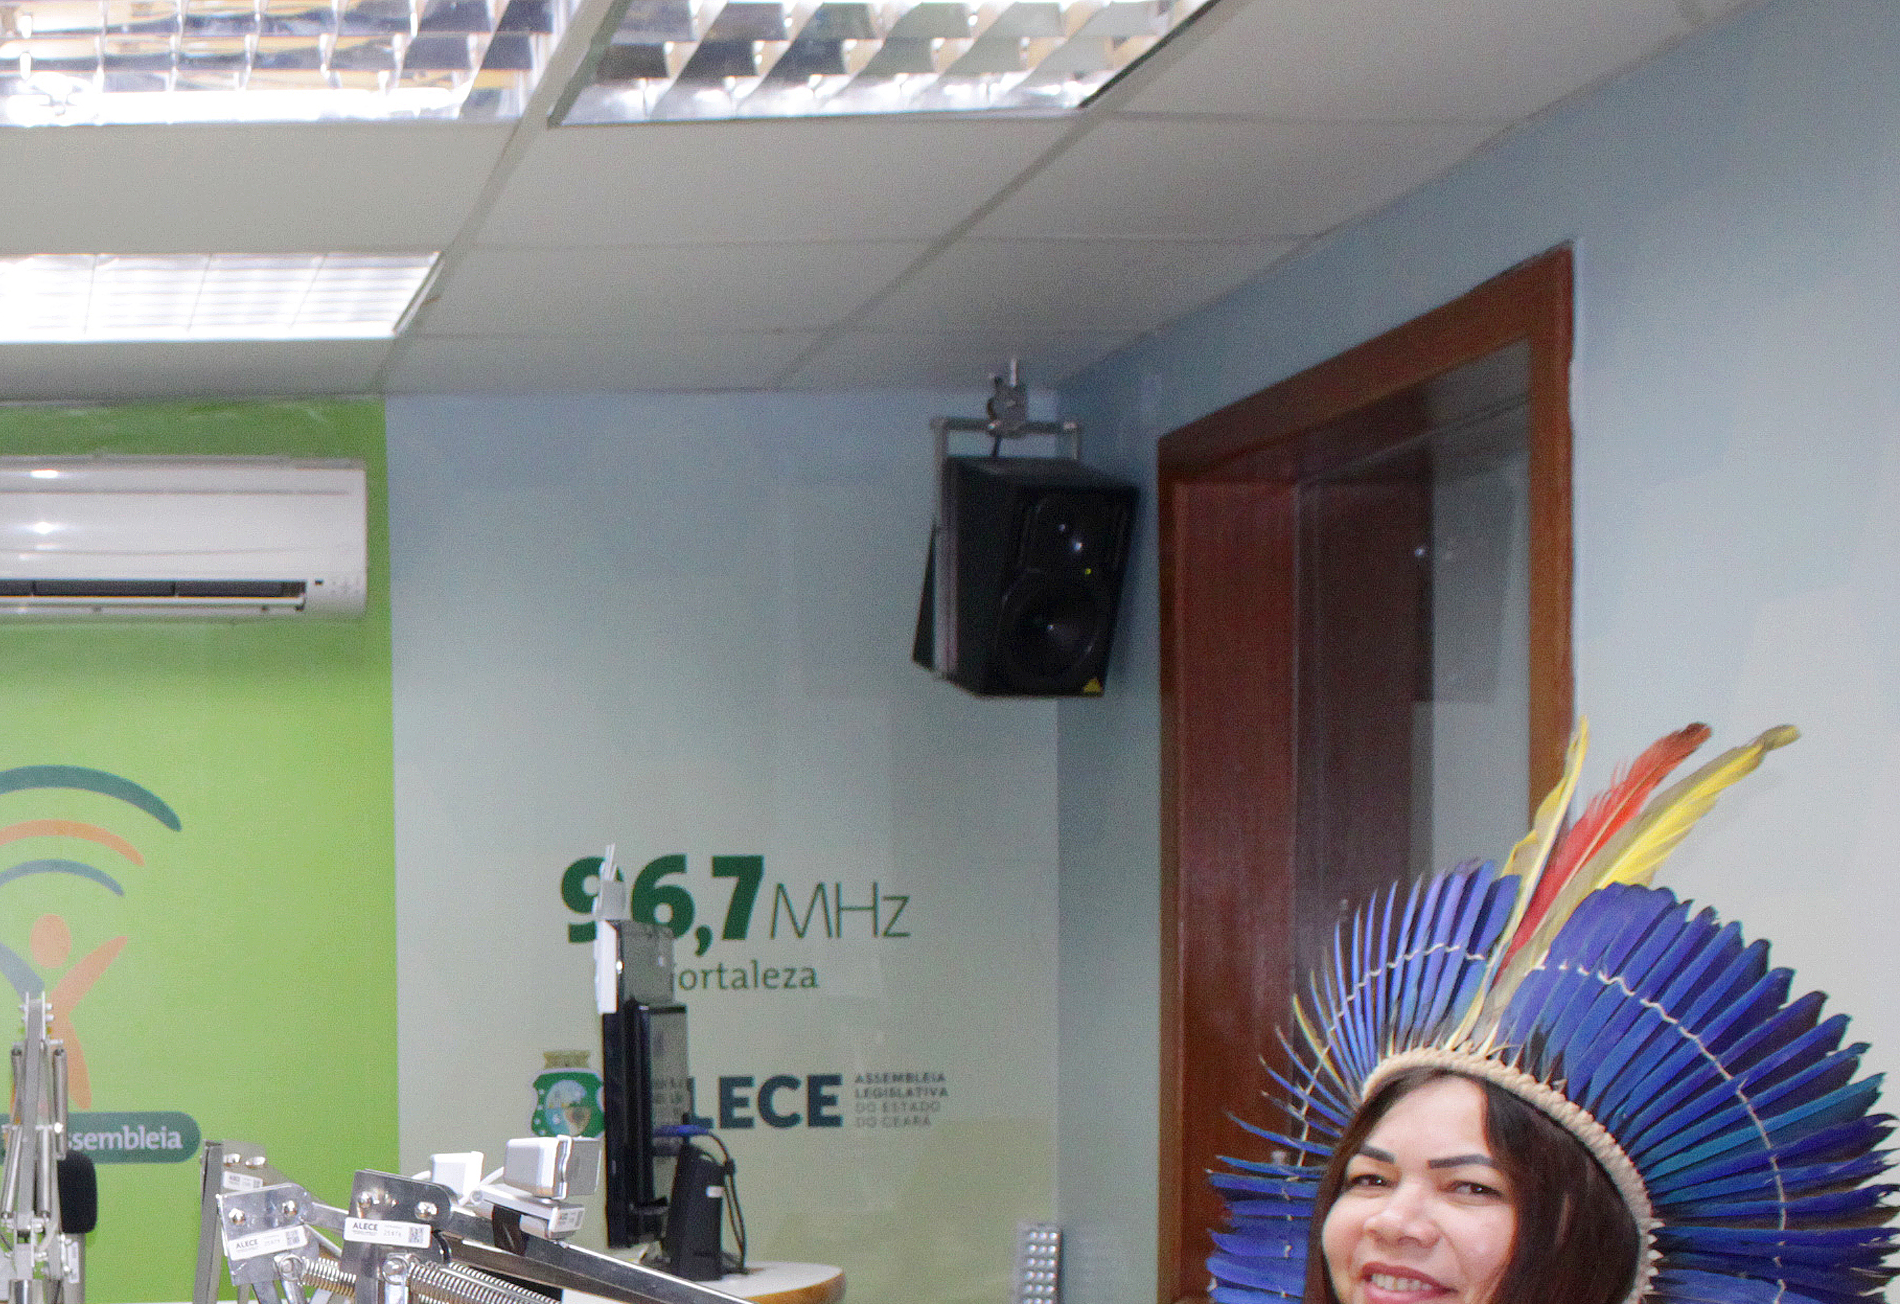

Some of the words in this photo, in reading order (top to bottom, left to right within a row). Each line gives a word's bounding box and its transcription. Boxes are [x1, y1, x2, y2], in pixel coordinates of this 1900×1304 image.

[560, 854, 765, 956] 96,7
[770, 881, 911, 940] MHz
[674, 959, 820, 992] ortaleza
[854, 1071, 946, 1084] ASSEMBLEIA
[686, 1073, 843, 1130] LECE
[854, 1086, 949, 1099] LEGISLATIVA
[352, 1223, 379, 1232] ALECE
